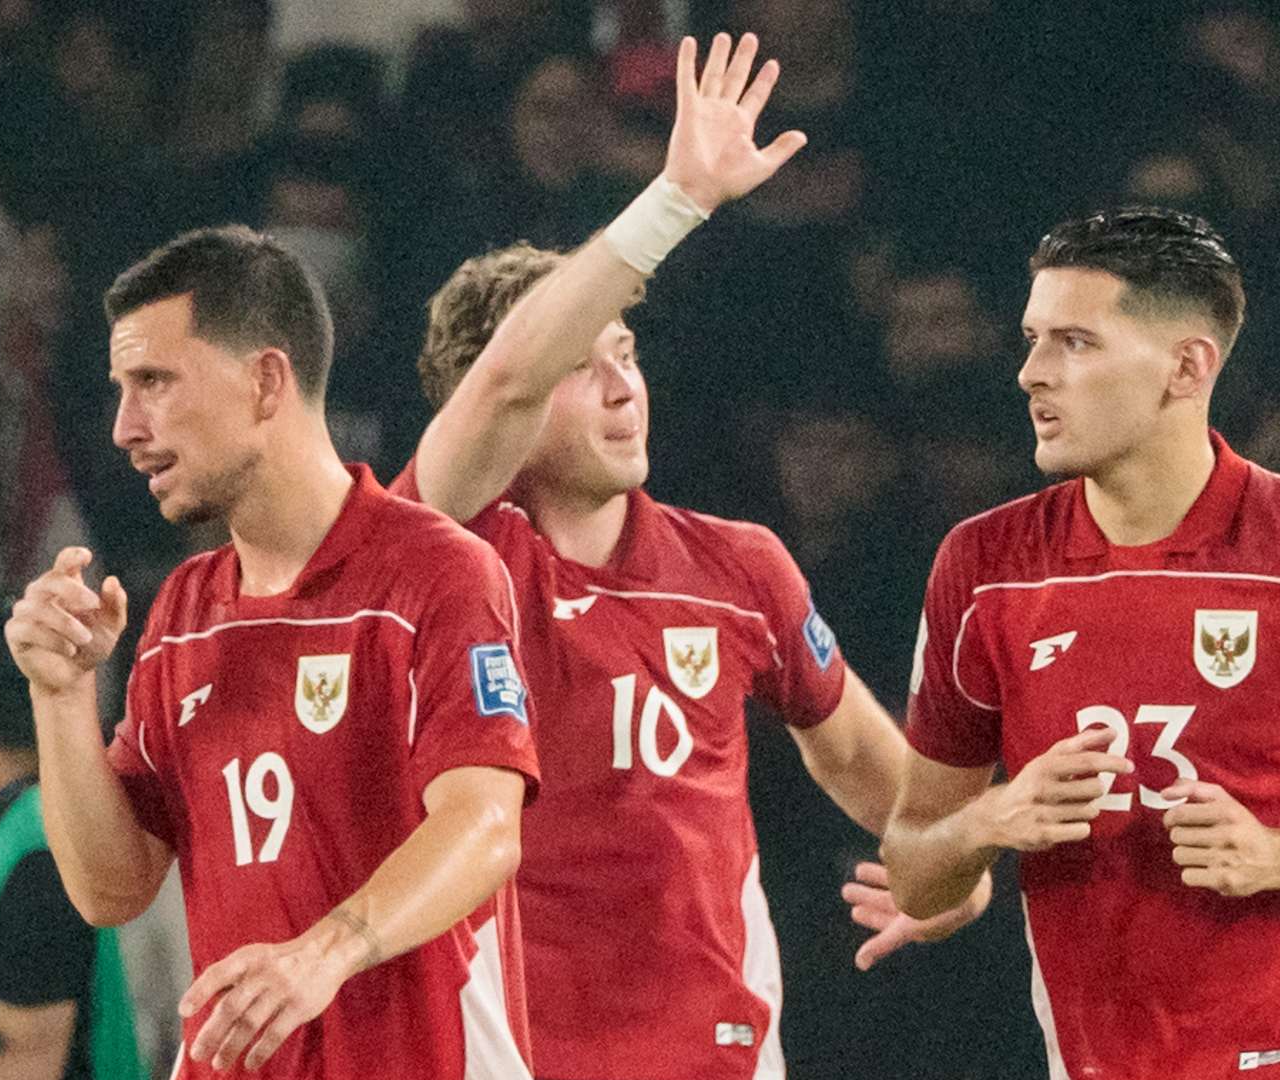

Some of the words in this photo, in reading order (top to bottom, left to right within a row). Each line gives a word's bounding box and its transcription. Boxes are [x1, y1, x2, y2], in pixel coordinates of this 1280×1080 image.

[611, 674, 695, 777] 10
[1076, 705, 1198, 812] 23
[222, 752, 295, 867] 19
